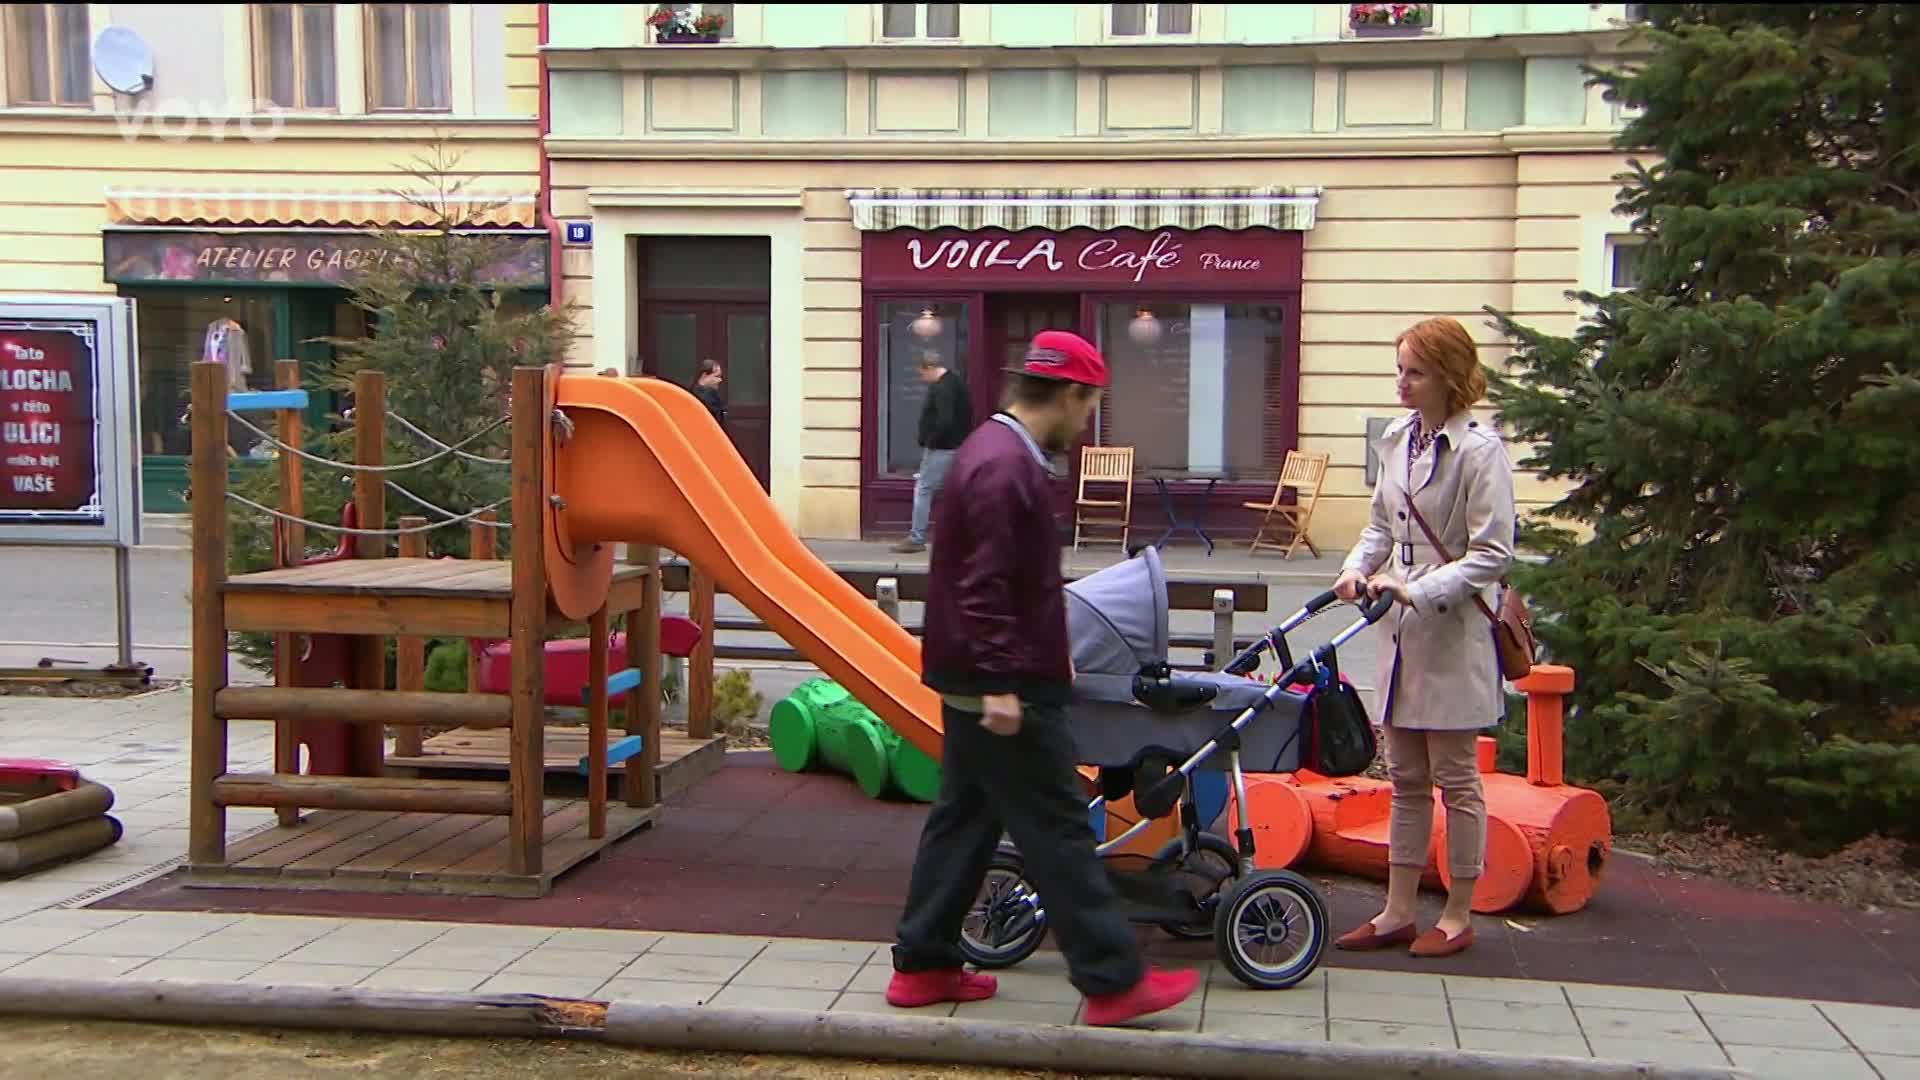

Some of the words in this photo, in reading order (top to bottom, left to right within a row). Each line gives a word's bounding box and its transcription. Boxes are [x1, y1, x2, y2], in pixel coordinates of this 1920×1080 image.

[197, 247, 297, 268] ATELIER
[907, 239, 1064, 270] VOILA
[1078, 231, 1184, 282] Café
[1199, 252, 1261, 271] France
[0, 368, 72, 392] LOCHA
[4, 421, 61, 444] ULICI
[13, 473, 56, 492] VAŠE
